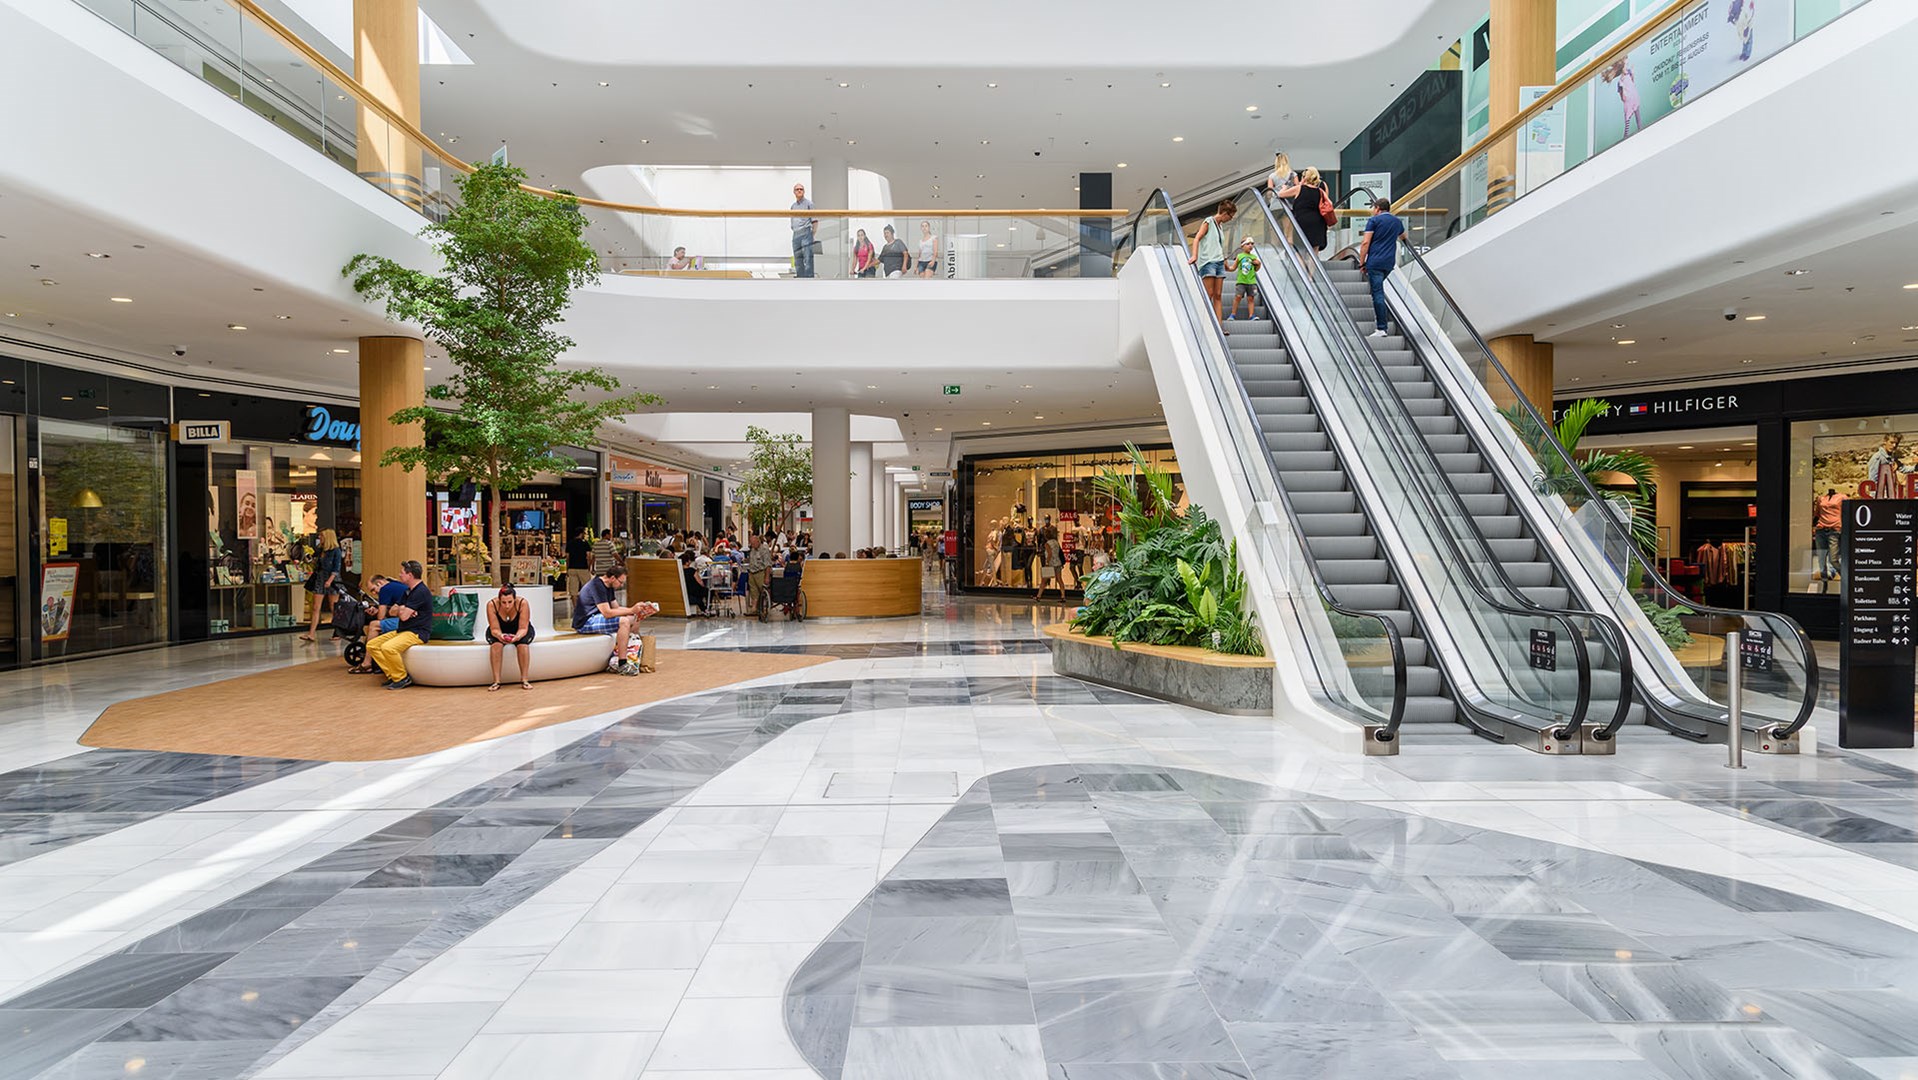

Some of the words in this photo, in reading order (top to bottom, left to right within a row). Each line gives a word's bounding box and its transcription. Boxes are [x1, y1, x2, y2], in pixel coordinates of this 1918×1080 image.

[1650, 7, 1709, 55] ENTERTANMENT
[1654, 395, 1739, 414] HILFIGER
[187, 426, 219, 439] BILLA
[1855, 505, 1871, 527] 0
